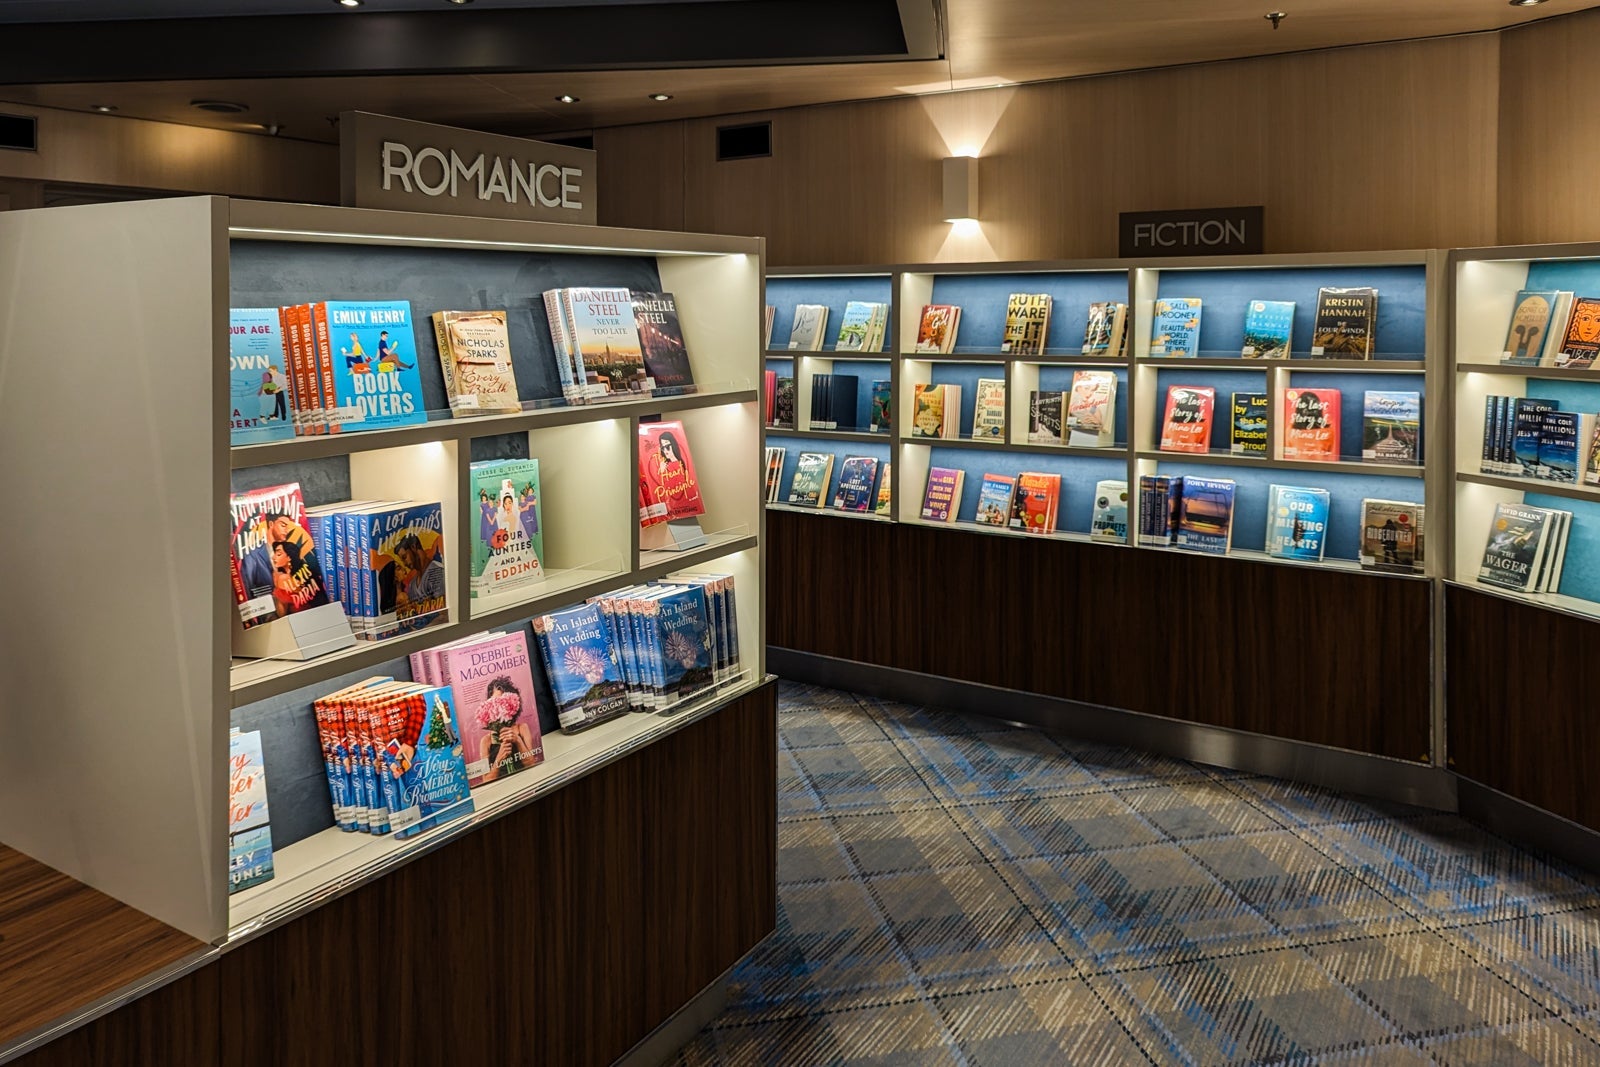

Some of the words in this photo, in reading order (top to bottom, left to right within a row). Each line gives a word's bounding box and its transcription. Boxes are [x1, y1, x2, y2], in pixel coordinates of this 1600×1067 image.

[383, 141, 583, 210] ROMANCE
[1134, 219, 1246, 247] FICTION
[574, 290, 631, 303] DANIELLE
[1010, 295, 1048, 306] RUTH
[1326, 298, 1364, 306] KRISTIN
[588, 304, 621, 316] STEEL
[1008, 307, 1046, 318] WARE
[1170, 302, 1190, 310] SALLY
[1322, 309, 1366, 317] HANNAH
[333, 310, 366, 324] EMILY
[370, 310, 405, 323] HENRY
[638, 313, 668, 324] STEEL
[1006, 326, 1024, 334] THE
[1024, 322, 1044, 338] IT
[457, 340, 504, 348] NICHOLAS
[320, 342, 330, 368] LOVERS
[466, 350, 498, 358] SPARKS
[1564, 348, 1596, 360] CIRCE
[324, 372, 332, 394] EMILY
[353, 372, 402, 394] BOOK
[1235, 406, 1247, 414] by
[1290, 398, 1307, 410] The
[1308, 399, 1330, 411] Last
[1170, 408, 1192, 423] Story
[1194, 410, 1205, 422] of
[1290, 412, 1316, 430] Story
[1318, 415, 1330, 428] of
[1290, 428, 1314, 440] Mina
[1542, 425, 1576, 435] MILLIONS
[658, 461, 684, 486] Heart
[942, 476, 954, 484] GIRL
[654, 470, 694, 503] Principle
[1207, 482, 1231, 490] IRVING
[230, 500, 256, 526] YOU
[259, 496, 282, 515] HAD
[284, 494, 304, 527] ME
[930, 501, 947, 510] VOICE
[1290, 502, 1313, 513] OUR
[1498, 507, 1518, 516] DAVID
[249, 516, 262, 530] AT
[372, 519, 381, 537] A
[386, 511, 408, 532] LOT
[236, 528, 268, 560] HOLA
[378, 526, 404, 555] LIKE
[496, 531, 522, 544] FOUR
[488, 540, 532, 558] AUNTIES
[1501, 550, 1516, 559] THE
[494, 559, 538, 581] EDDING
[501, 558, 515, 566] AND
[1486, 554, 1528, 575] WAGER
[283, 564, 312, 593] ALEXIS
[292, 580, 320, 608] DARIA
[417, 596, 444, 615] DARIA
[661, 608, 672, 618] An
[674, 598, 698, 613] Island
[555, 622, 568, 633] An
[570, 613, 599, 628] Island
[664, 614, 698, 631] Wedding
[560, 628, 601, 646] Wedding
[471, 646, 512, 666] DEBBIE
[460, 655, 527, 682] MACOMBER
[597, 700, 623, 715] COLGAN
[388, 718, 404, 726] ADAMS
[496, 755, 513, 770] Love
[514, 747, 542, 762] Flowers
[414, 754, 456, 780] Very
[421, 771, 456, 794] MERRY
[404, 783, 459, 806] Bromance
